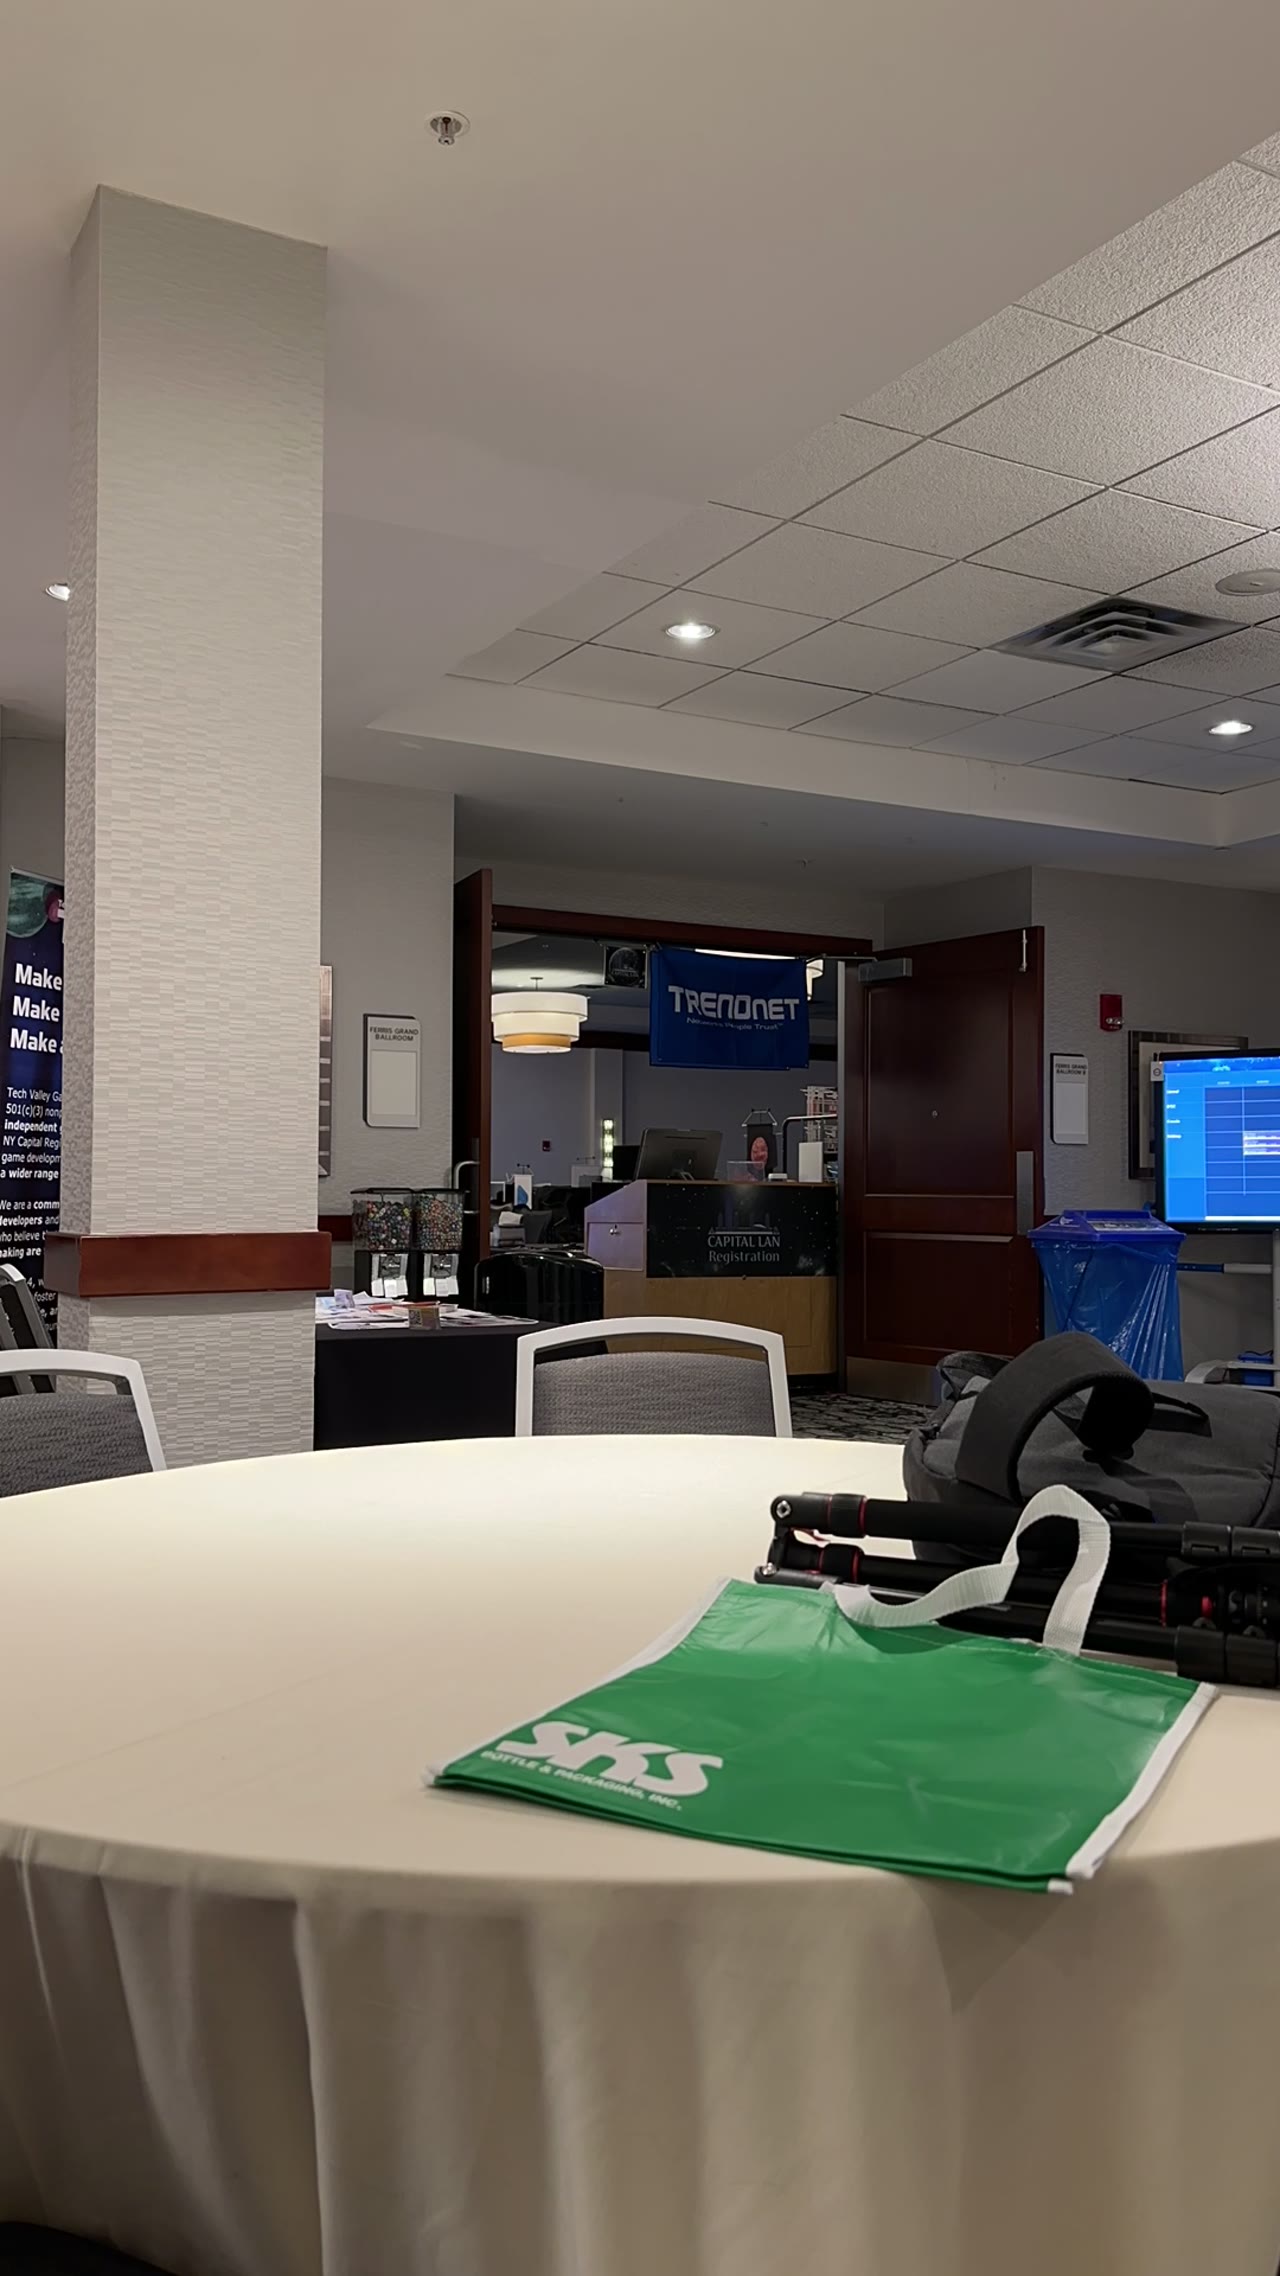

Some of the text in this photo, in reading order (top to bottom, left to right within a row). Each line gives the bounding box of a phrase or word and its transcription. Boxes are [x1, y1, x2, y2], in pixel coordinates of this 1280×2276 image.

[15, 963, 63, 991] Make
[12, 995, 60, 1022] Make
[370, 1026, 419, 1036] FERRIS GRAND
[10, 1027, 57, 1053] Make
[7, 1087, 27, 1099] Tech
[29, 1089, 51, 1103] Valley
[6, 1103, 43, 1118] 501(c)(3)
[4, 1119, 57, 1133] independent
[3, 1135, 16, 1146] NY
[17, 1136, 43, 1149] Capital
[1, 1153, 25, 1165] game
[0, 1167, 59, 1181] a wider range
[13, 1201, 26, 1210] are
[26, 1202, 32, 1210] a
[13, 1230, 40, 1241] believe
[708, 1235, 781, 1248] CAPITAL LAN
[26, 1247, 42, 1256] are
[709, 1250, 781, 1265] Registration
[496, 1721, 723, 1796] SKS
[481, 1750, 540, 1770] BOTTLE
[539, 1764, 551, 1775] &
[648, 1792, 683, 1811] INC.
